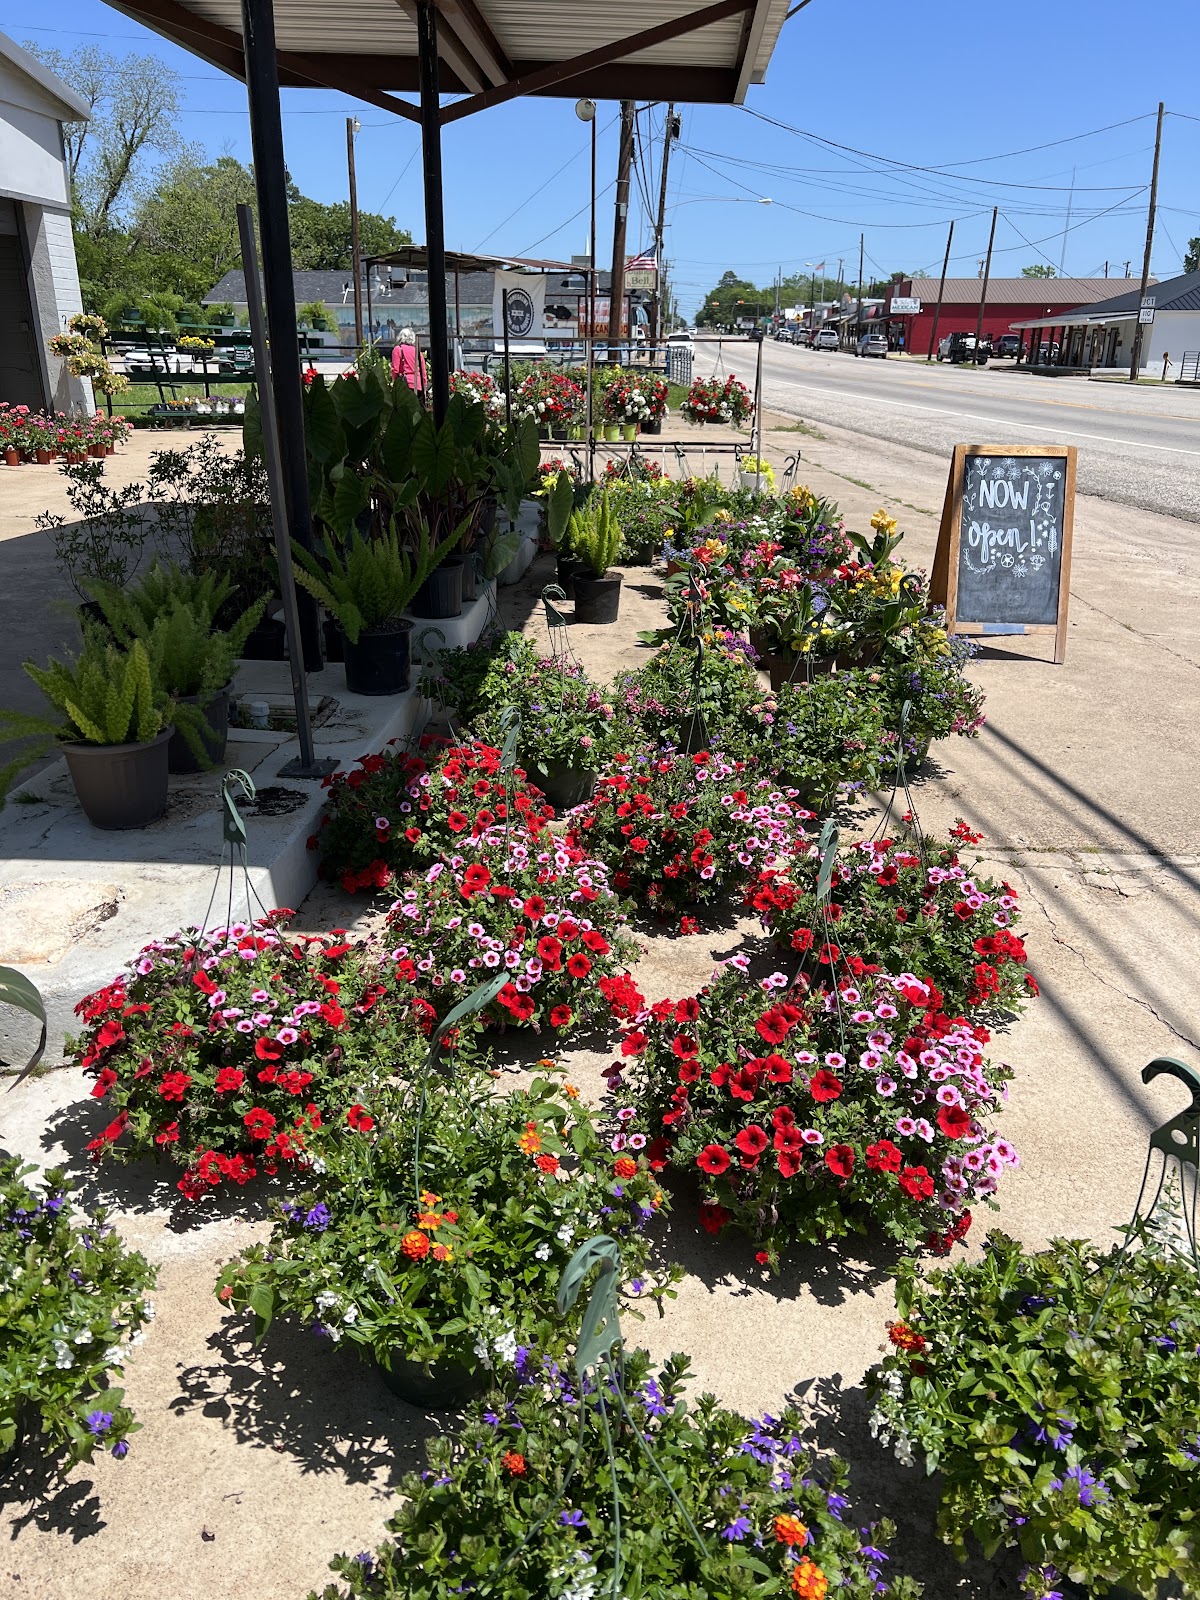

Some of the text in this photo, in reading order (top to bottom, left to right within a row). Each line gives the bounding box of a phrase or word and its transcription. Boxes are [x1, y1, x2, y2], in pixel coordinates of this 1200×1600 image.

[631, 276, 649, 285] Bell
[580, 324, 609, 334] MCAN
[979, 480, 1030, 510] NOW
